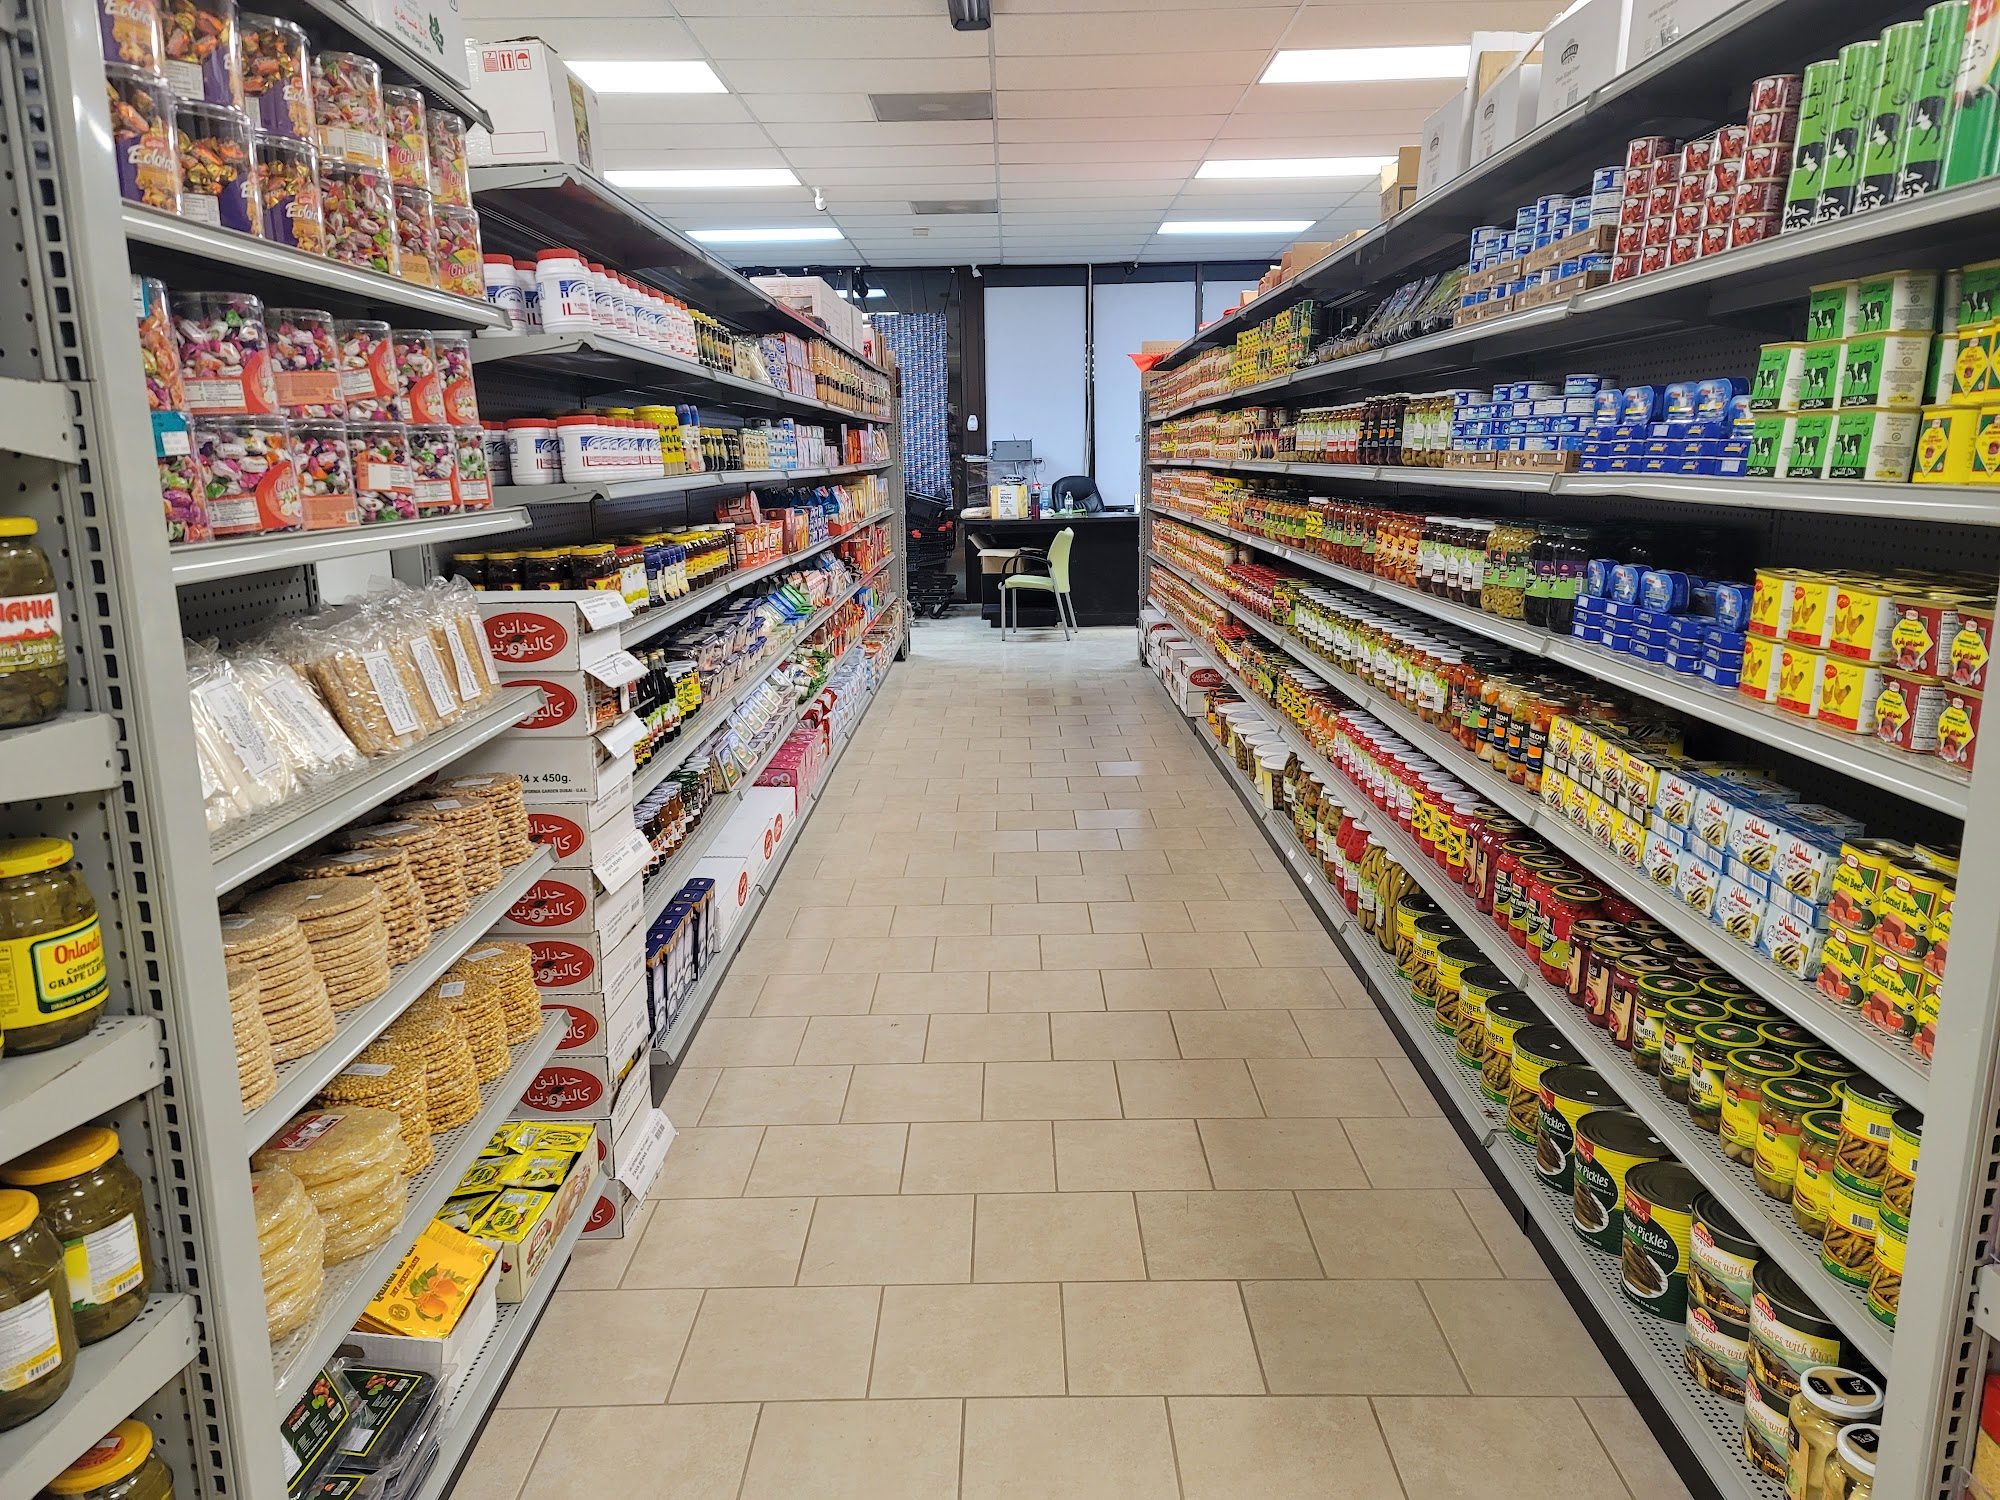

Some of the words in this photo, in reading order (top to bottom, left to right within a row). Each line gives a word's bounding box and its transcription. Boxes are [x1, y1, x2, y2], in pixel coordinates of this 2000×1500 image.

[493, 619, 546, 638] حدائق
[542, 773, 572, 785] 450g.
[1667, 778, 1685, 796] سلطان
[1706, 798, 1723, 816] سلطان
[1745, 818, 1771, 840] سلطان
[1654, 839, 1673, 859] سلطان
[1789, 841, 1813, 865] سلطان
[1690, 860, 1707, 878] سلطان
[1848, 877, 1865, 893] Beef
[1730, 887, 1753, 909] سلطان
[1882, 892, 1901, 913] Corned
[1901, 900, 1920, 918] Beef
[510, 900, 575, 923] كاليفورنيا
[1778, 914, 1802, 938] سلطان
[1838, 950, 1853, 968] Beef
[49, 971, 87, 990] GRAPE
[1870, 969, 1890, 991] Corned
[1890, 979, 1908, 998] Beef
[533, 1071, 583, 1090] حدائق
[526, 1086, 592, 1108] كاليفورنيا
[1543, 1112, 1566, 1133] Pickles
[1583, 1166, 1609, 1188] Pickles
[1587, 1181, 1615, 1197] Concombres
[1638, 1228, 1669, 1250] Pickles
[1693, 1225, 1714, 1247] BARAKA
[1642, 1243, 1675, 1260] Concombres
[1699, 1248, 1722, 1270] Leaves
[1722, 1260, 1744, 1278] with
[1719, 1298, 1747, 1316] (2000g)
[1753, 1296, 1775, 1322] BARAKA
[1693, 1312, 1718, 1333] BARAKA
[1701, 1334, 1725, 1355] Leaves
[1726, 1342, 1748, 1362] with
[1760, 1320, 1783, 1346] Leaves
[1784, 1334, 1808, 1355] with
[1809, 1342, 1833, 1362] Rice
[1749, 1404, 1767, 1424] Leaves
[1768, 1418, 1789, 1438] with
